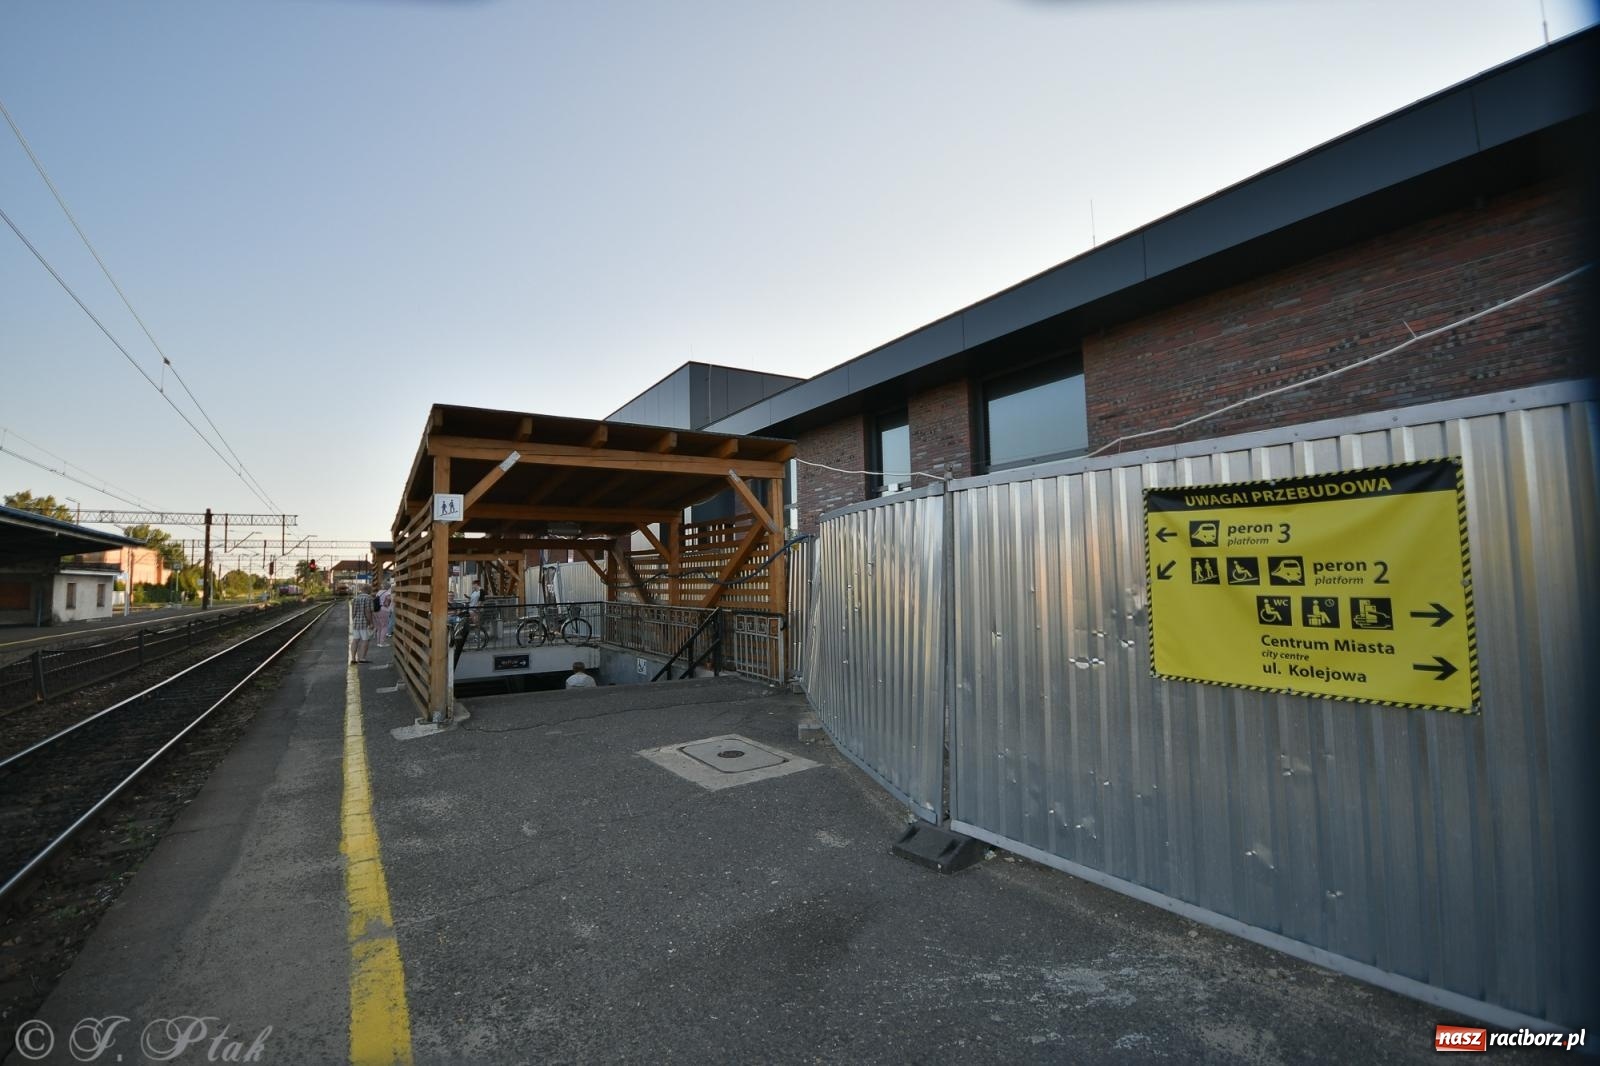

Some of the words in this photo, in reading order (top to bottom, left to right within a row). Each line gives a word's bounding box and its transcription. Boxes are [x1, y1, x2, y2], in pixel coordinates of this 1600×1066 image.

[1184, 493, 1249, 507] UWAGA!
[1251, 477, 1392, 503] PRZEBUDOWA
[1227, 524, 1273, 537] peron
[1277, 523, 1291, 543] 3
[1227, 537, 1269, 547] platform
[1313, 561, 1367, 575] peron
[1373, 561, 1390, 584] 2
[1314, 575, 1364, 586] platform
[1273, 599, 1289, 607] WC
[1261, 634, 1329, 651] Centrum
[1334, 639, 1395, 655] Miasta
[1261, 650, 1278, 660] city
[1280, 653, 1310, 661] centre
[1263, 662, 1282, 675] ul.
[1289, 664, 1367, 683] Kolejowa
